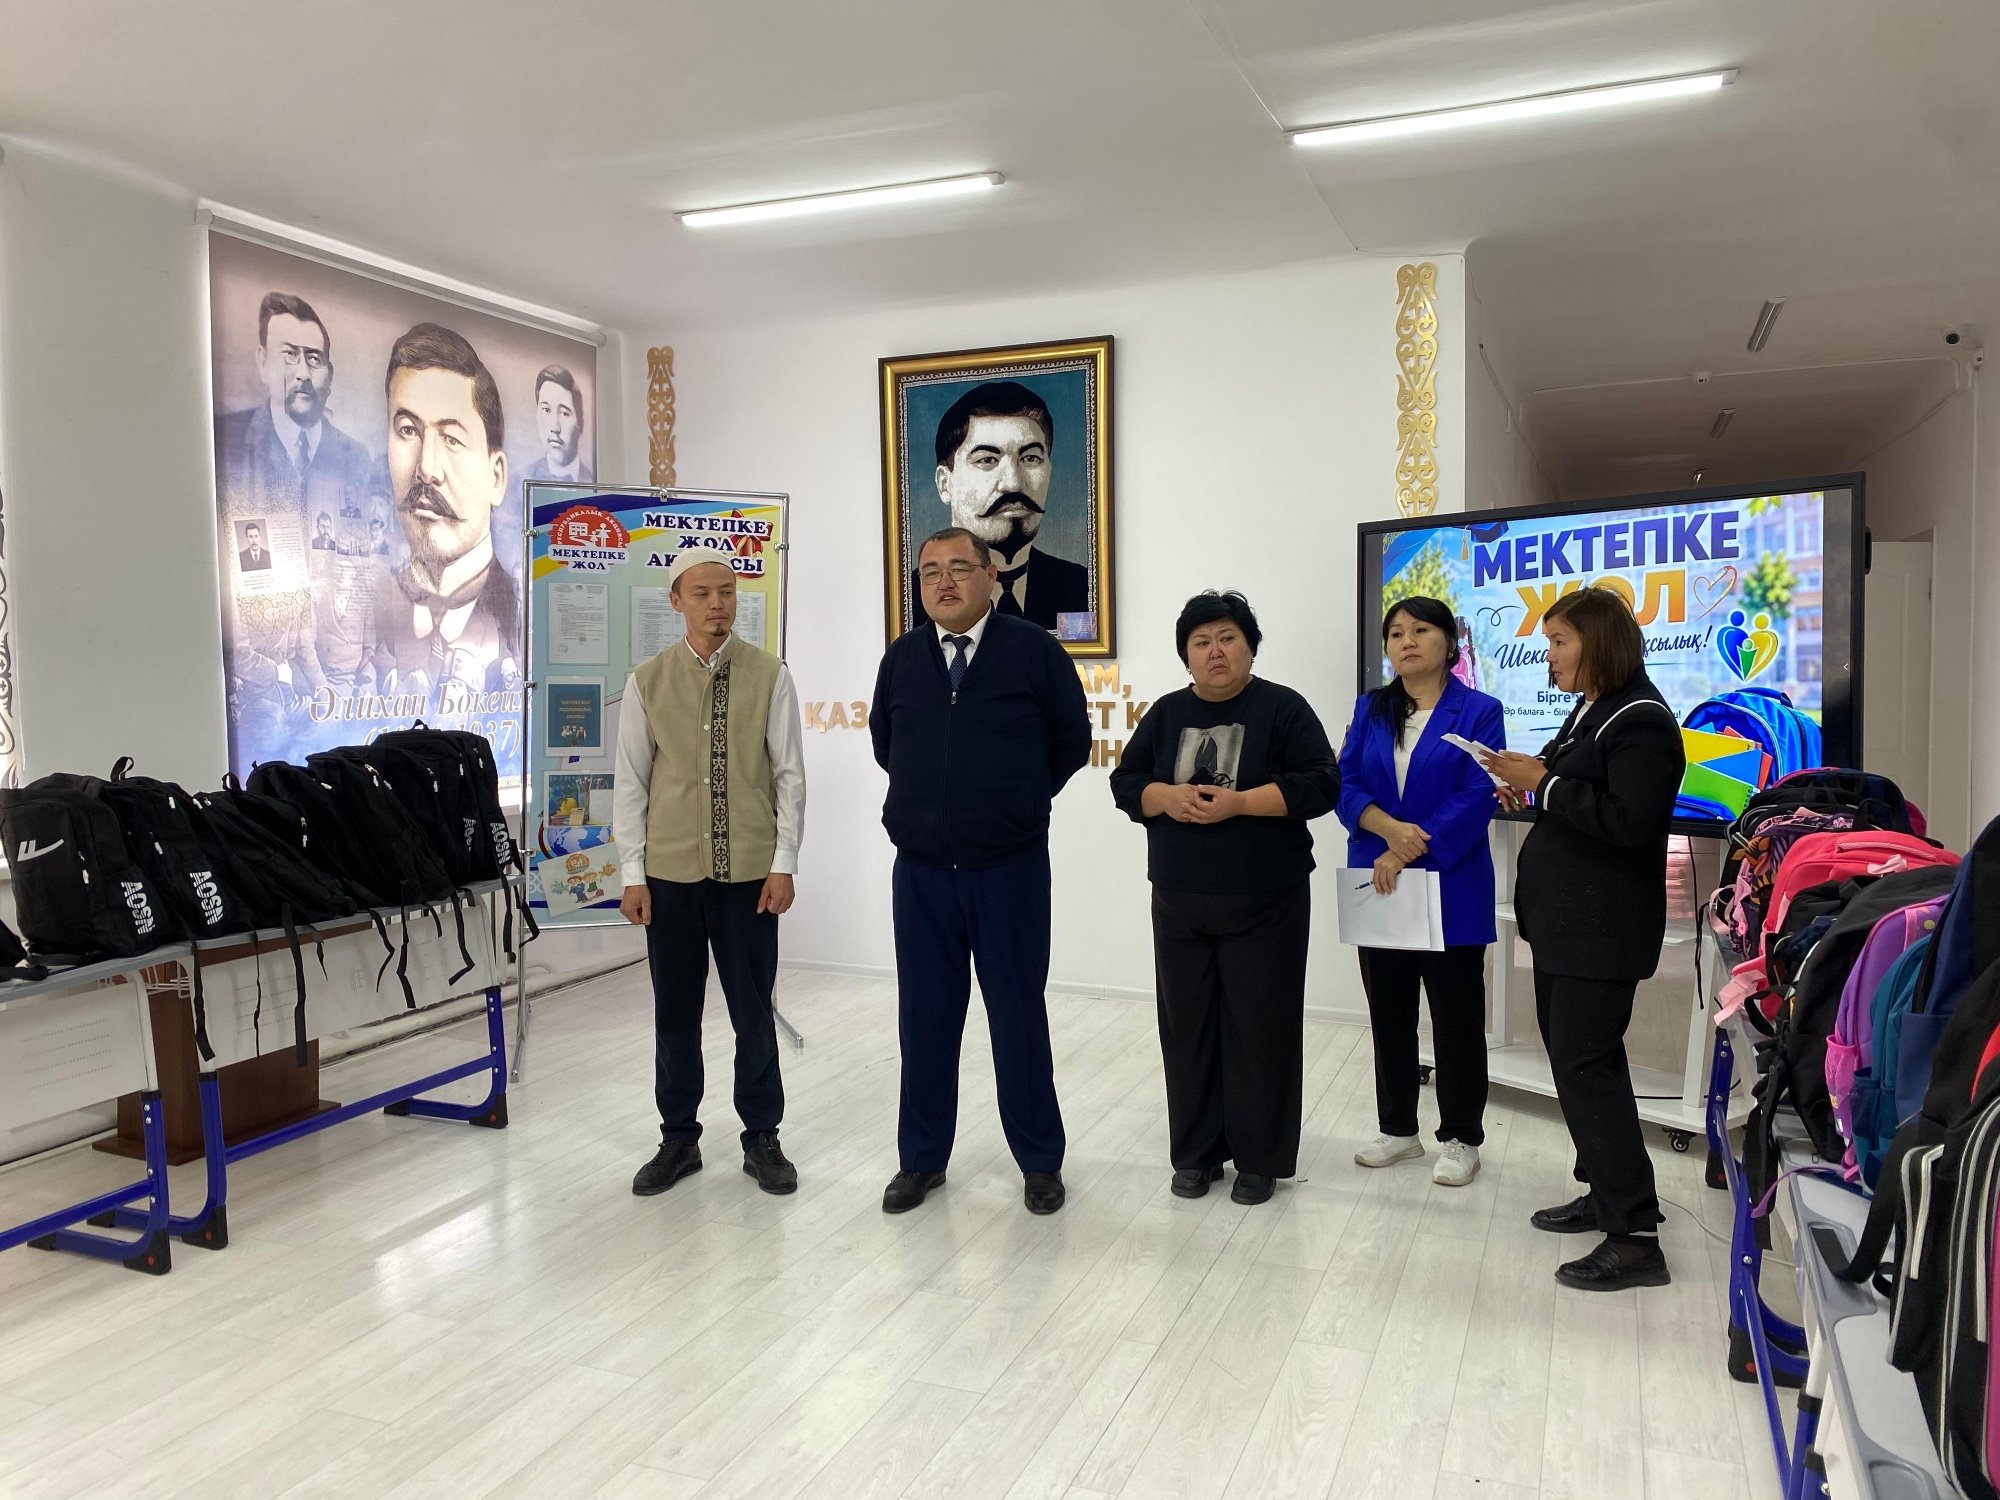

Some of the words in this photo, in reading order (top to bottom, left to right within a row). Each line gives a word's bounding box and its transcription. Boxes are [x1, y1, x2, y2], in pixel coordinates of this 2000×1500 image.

[645, 513, 766, 534] МЕКТЕПКЕ
[678, 535, 734, 551] ЖОЛ
[1474, 510, 1739, 587] МЕКТЕПКЕ
[552, 548, 625, 560] МЕКТЕПКЕ
[647, 553, 763, 571] АКСЫ
[571, 560, 606, 570] ЖОЛ
[309, 685, 428, 722] Әлихан
[1537, 690, 1571, 705] Бірге
[1517, 706, 1545, 716] балаға
[190, 871, 224, 925] AOSN
[120, 881, 156, 935] AOSN
